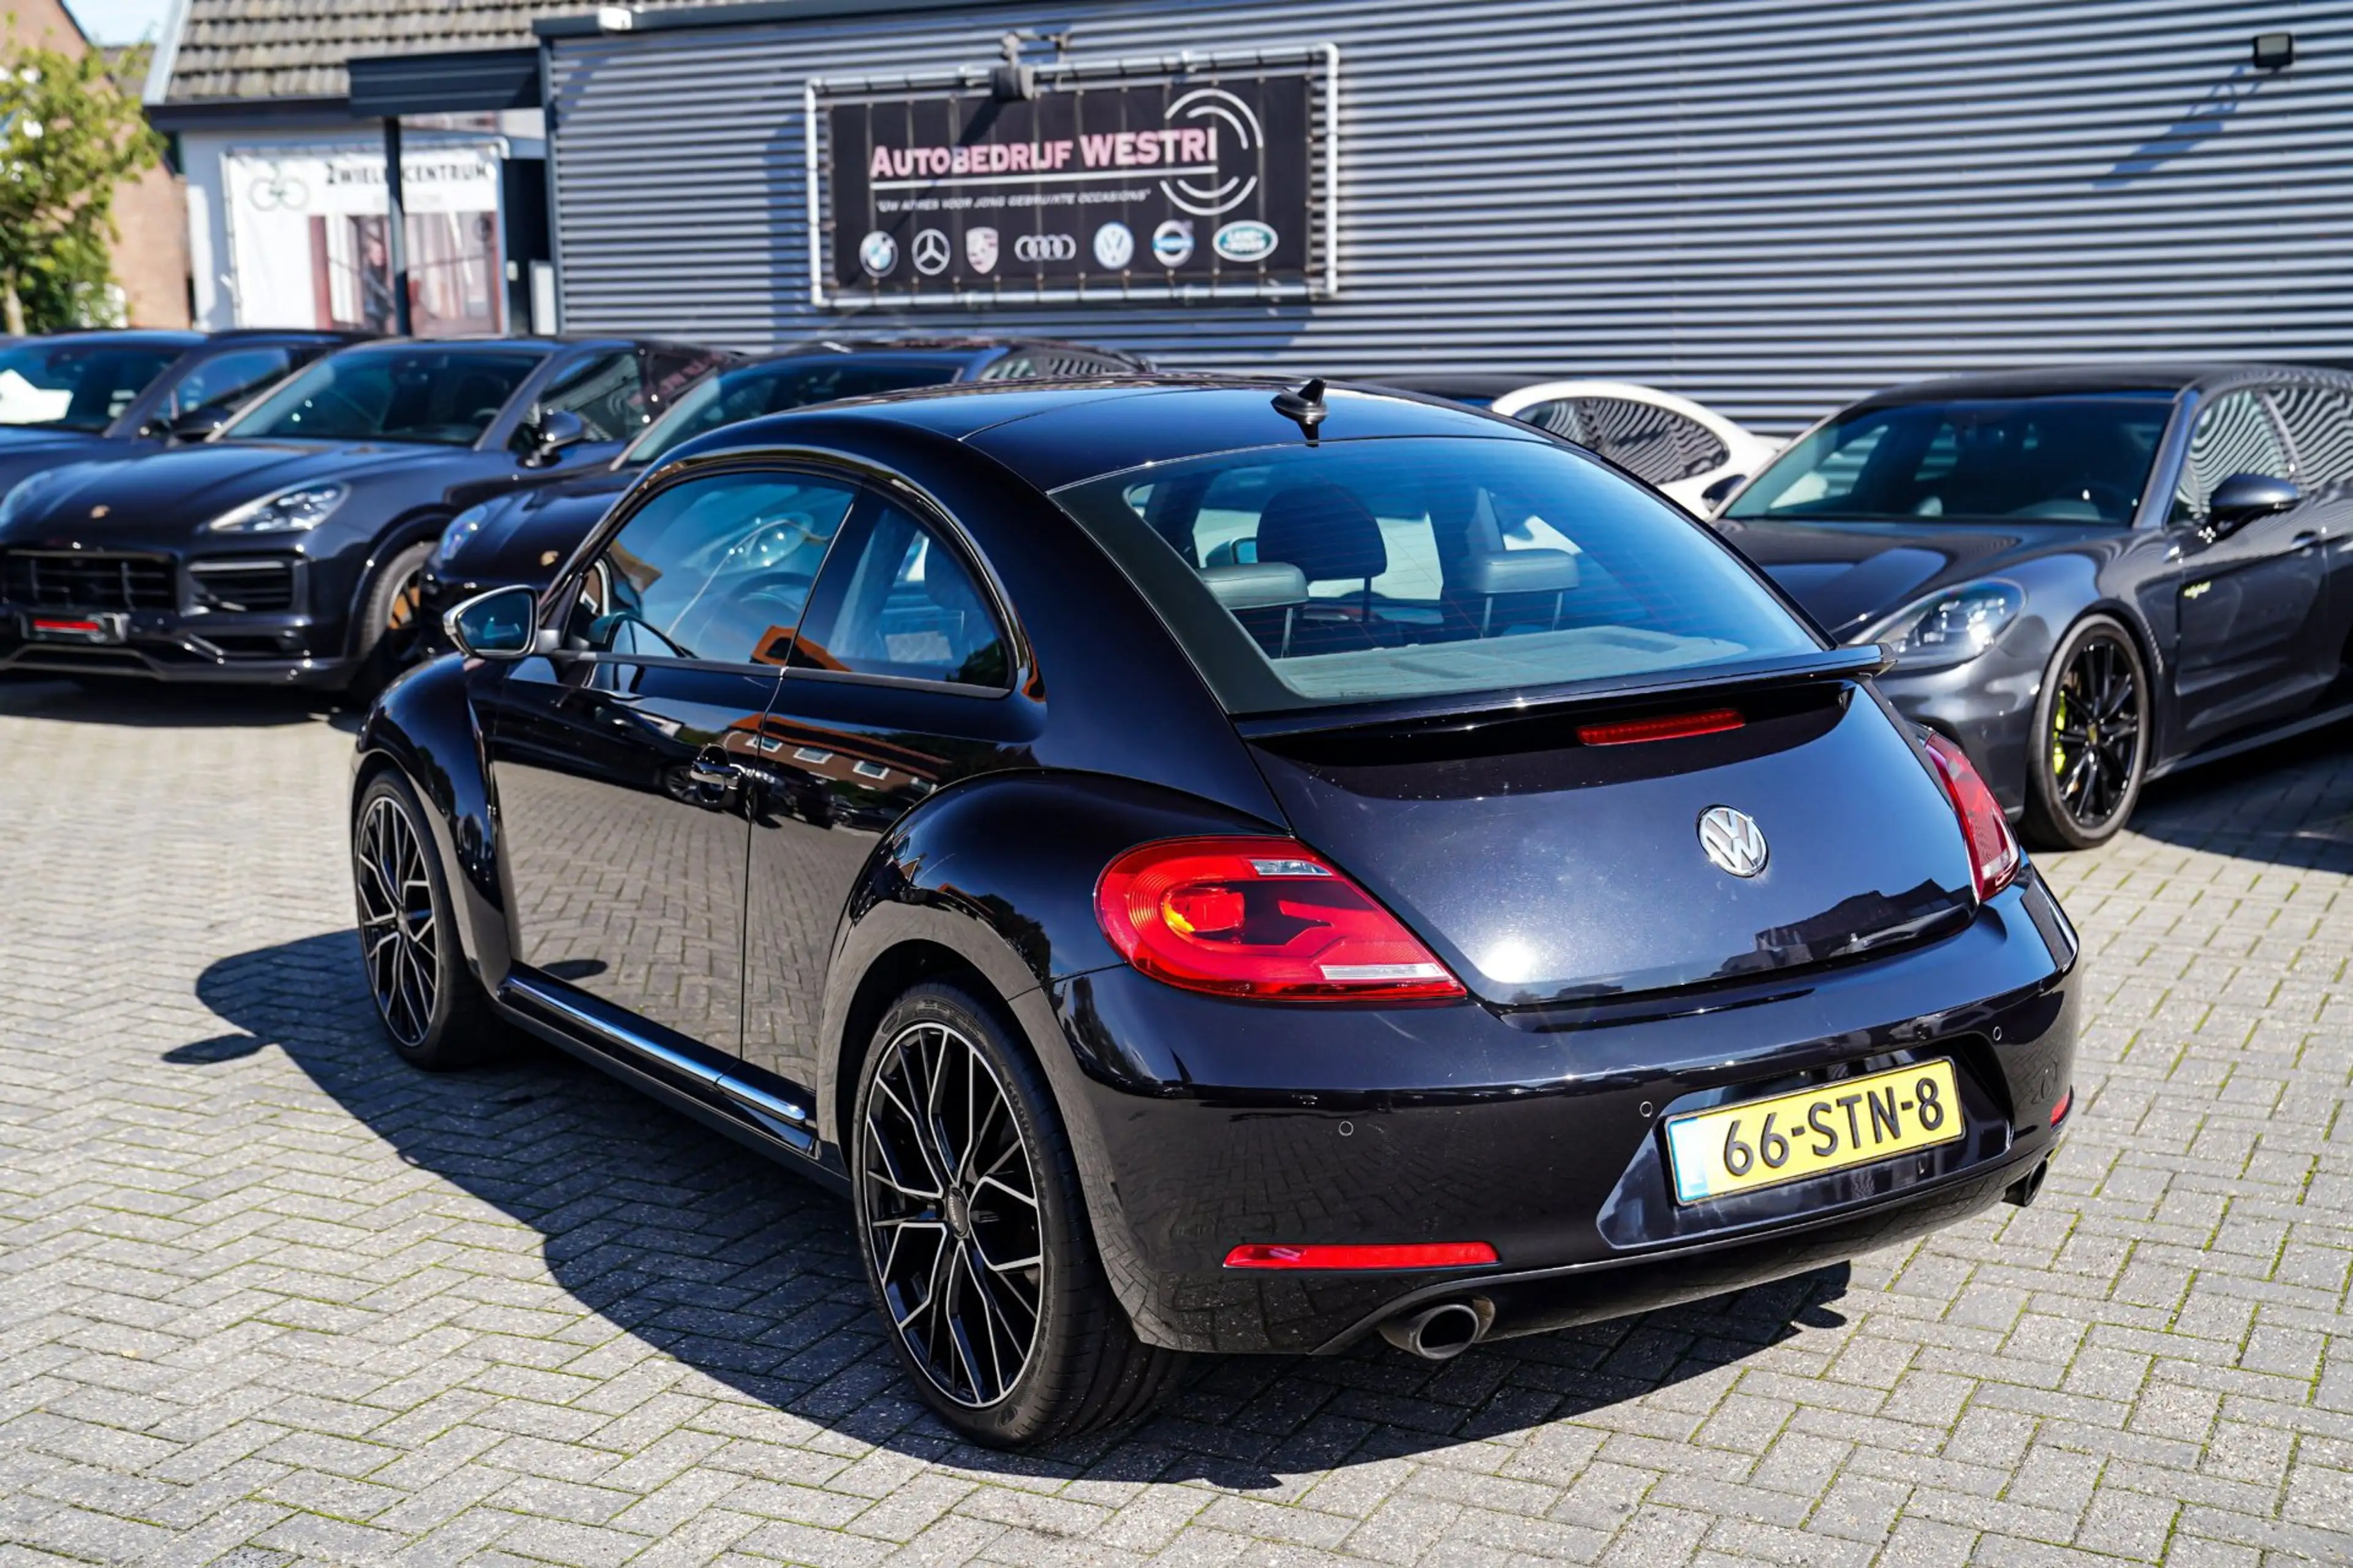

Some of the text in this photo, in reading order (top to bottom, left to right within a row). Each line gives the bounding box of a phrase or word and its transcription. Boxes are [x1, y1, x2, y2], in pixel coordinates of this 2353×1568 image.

[870, 127, 1218, 178] AUTOBEDRIJF WESTRI
[1722, 1077, 1945, 1176] 66-STN-8
